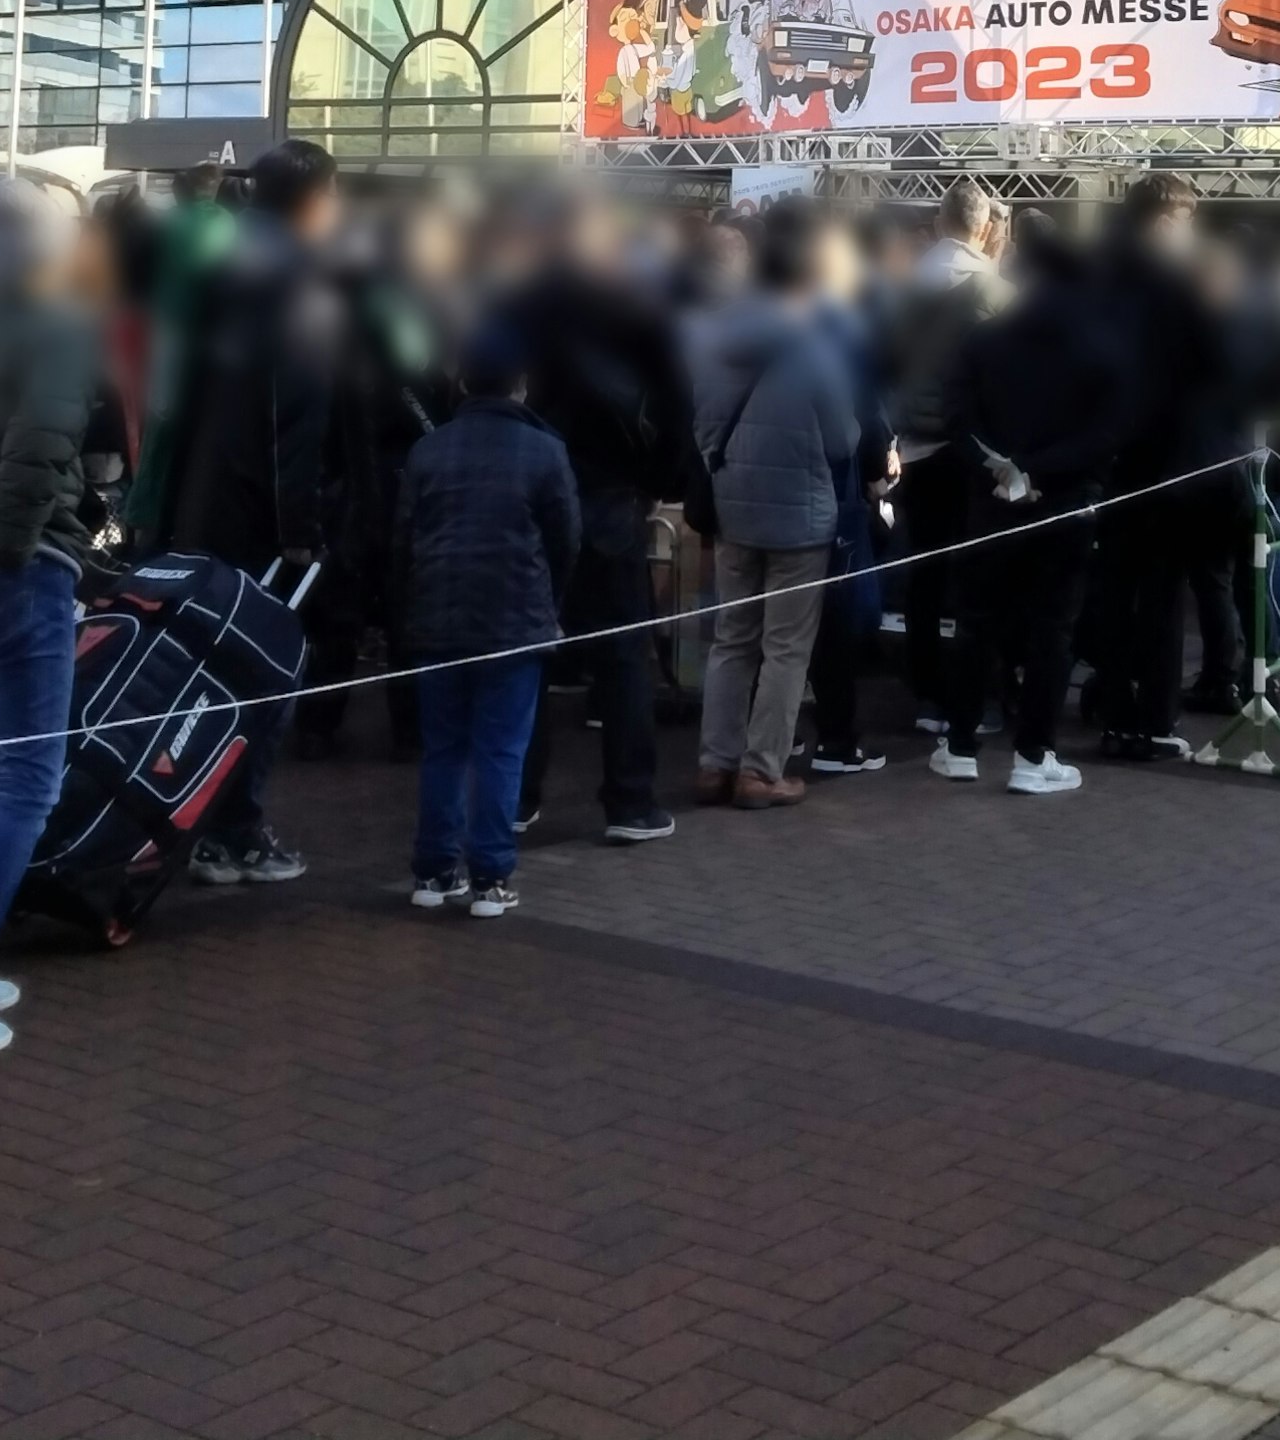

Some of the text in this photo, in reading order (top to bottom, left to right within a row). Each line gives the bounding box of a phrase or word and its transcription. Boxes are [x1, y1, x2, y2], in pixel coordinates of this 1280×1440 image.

[876, 4, 976, 36] OSAKA
[984, 0, 1072, 30] AUTO
[910, 43, 1152, 104] 2023
[219, 140, 236, 165] A
